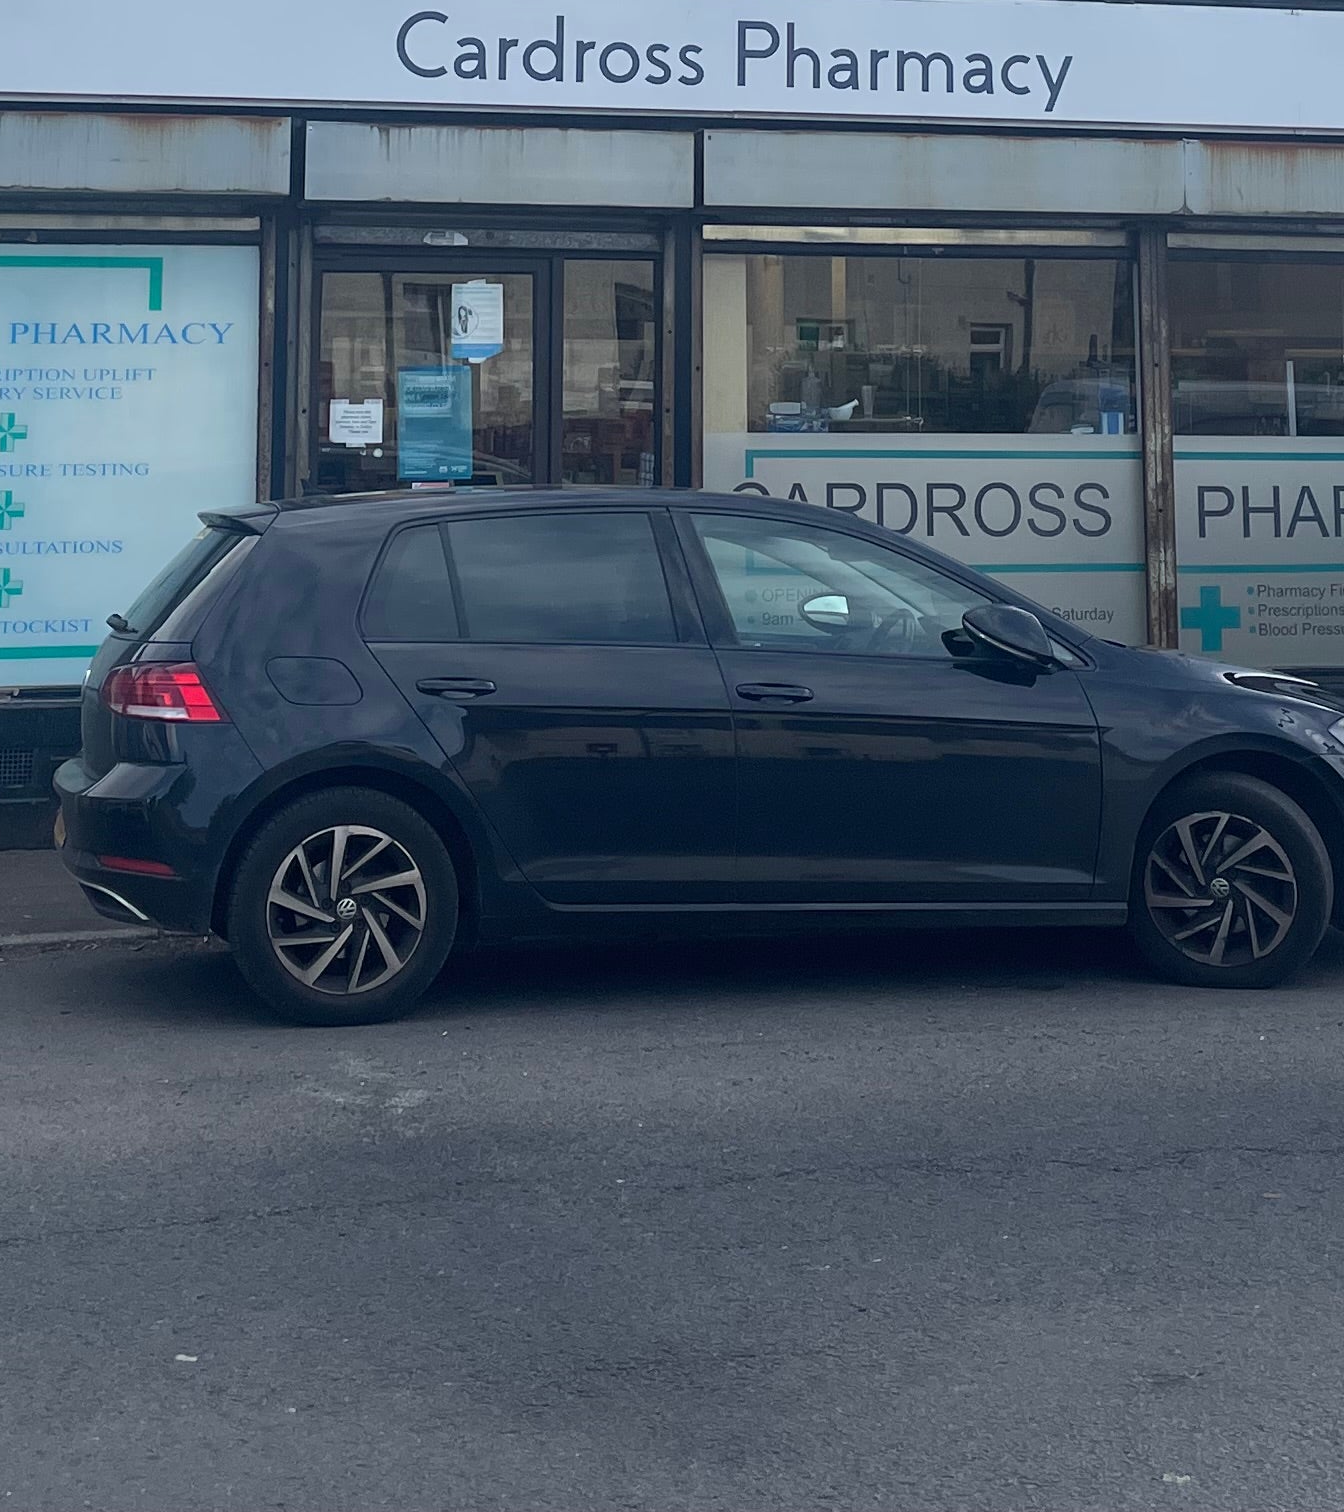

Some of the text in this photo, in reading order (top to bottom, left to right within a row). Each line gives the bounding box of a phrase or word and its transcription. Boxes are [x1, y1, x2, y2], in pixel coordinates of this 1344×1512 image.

[396, 11, 1073, 112] Cardross Pharmacy
[9, 322, 235, 345] PHARMACY
[83, 368, 157, 382] UPLIFT
[32, 386, 123, 400] SERVICE
[58, 462, 150, 477] TESTING
[732, 482, 1113, 538] RDROSS
[1256, 584, 1326, 600] Pharmacy
[761, 612, 794, 626] 9am
[1258, 622, 1298, 637] Blood
